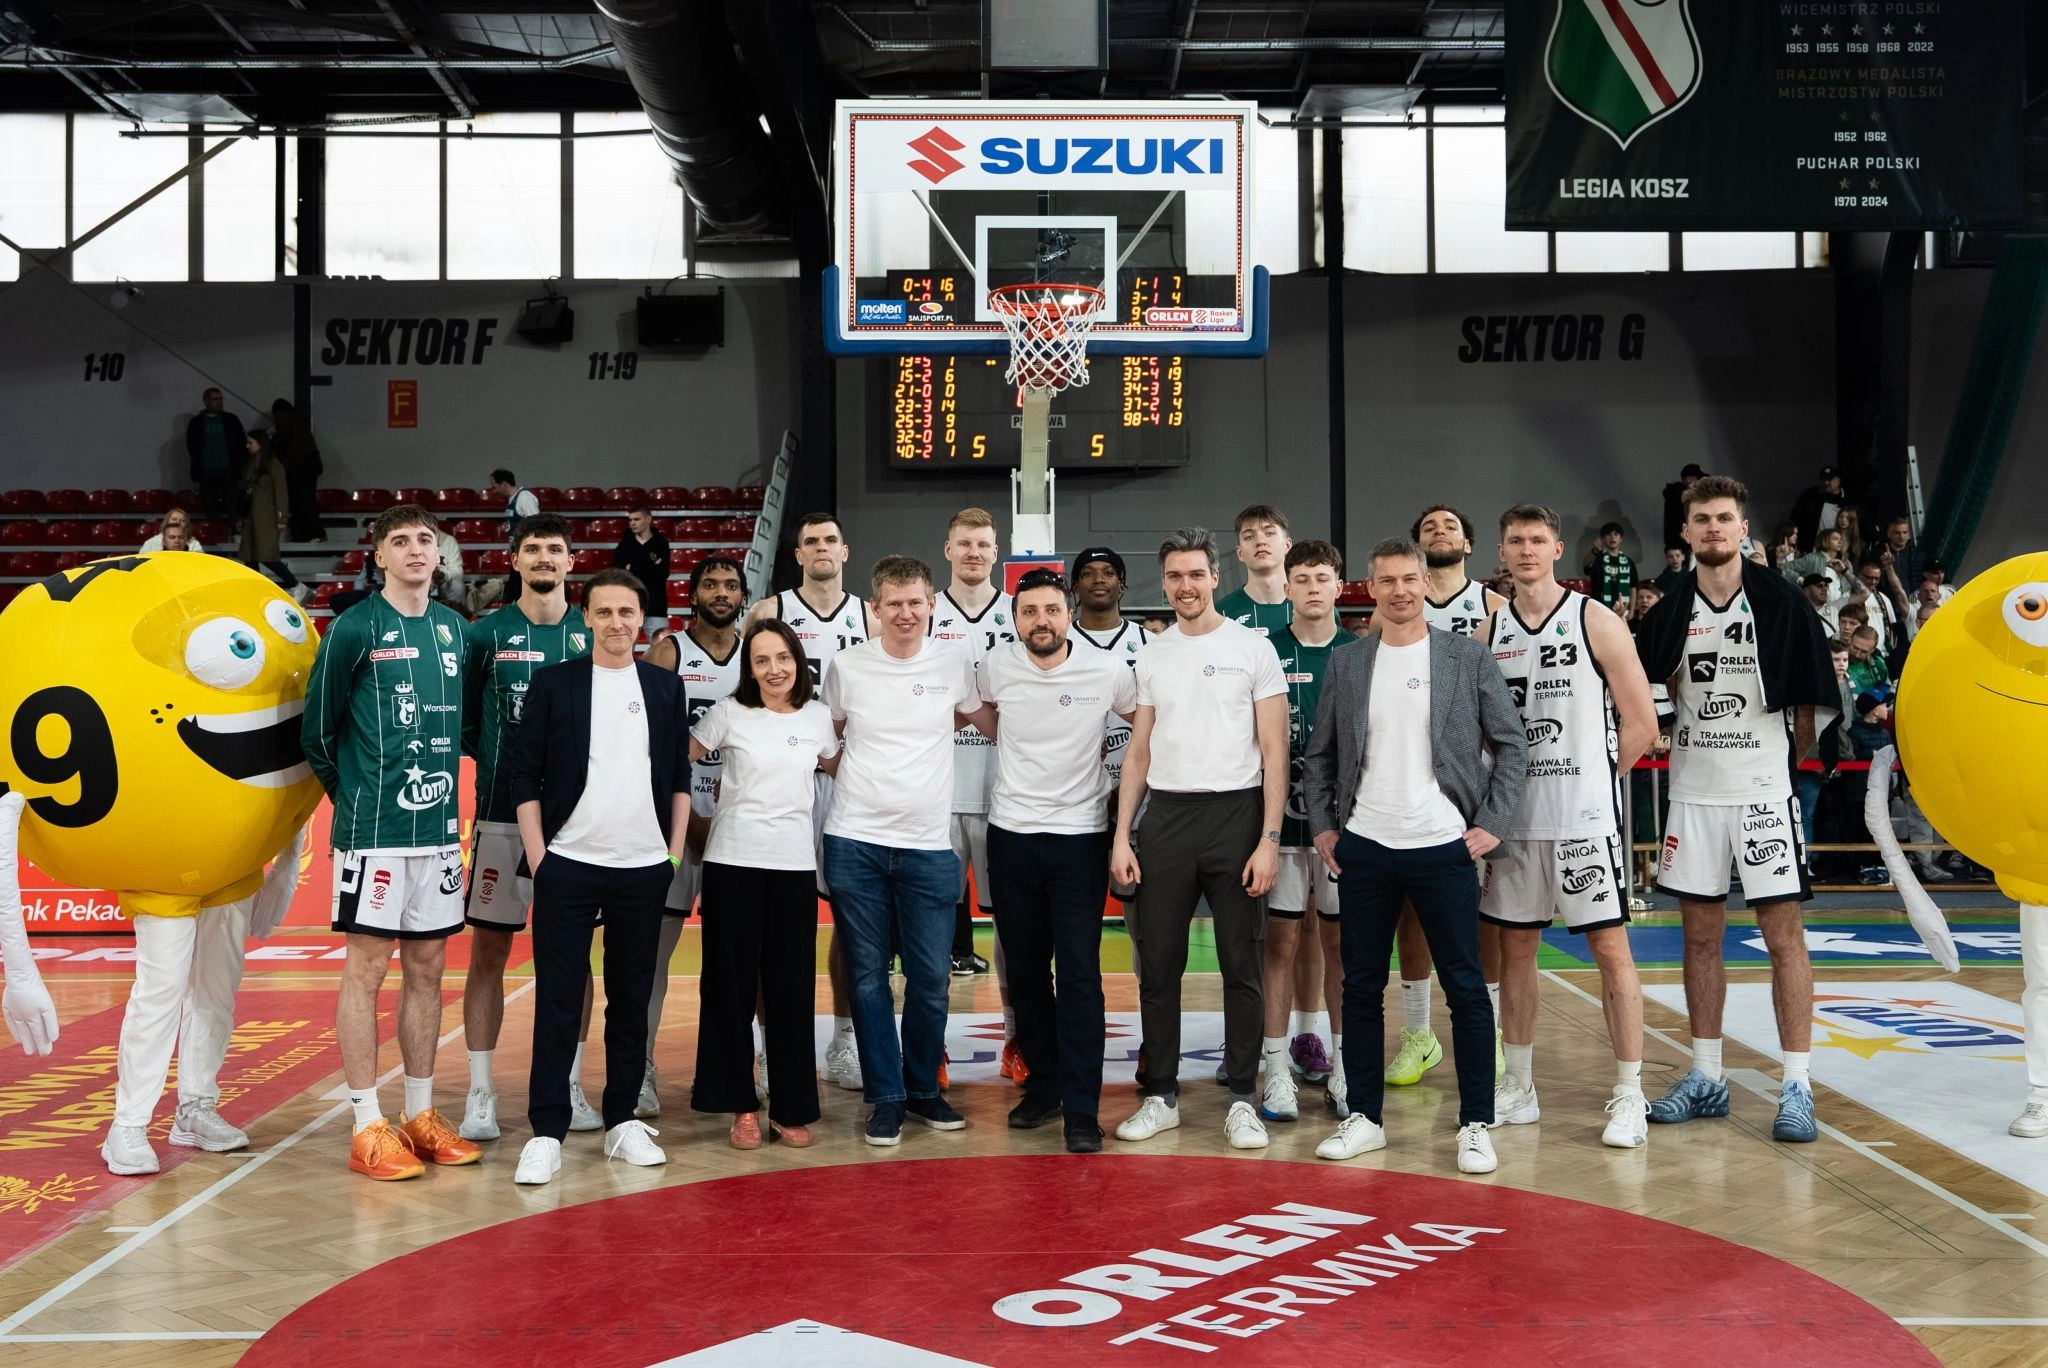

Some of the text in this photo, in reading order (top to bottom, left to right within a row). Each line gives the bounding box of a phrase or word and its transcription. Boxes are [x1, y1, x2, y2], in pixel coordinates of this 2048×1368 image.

[1780, 3, 1941, 15] WICEMISTRZ POLSKI
[1786, 43, 1809, 53] 1953
[1816, 43, 1839, 53] 1955
[1907, 42, 1934, 52] 2022
[1776, 67, 1945, 82] BRĄZOWY MEDALISTA
[1778, 86, 1943, 98] MISTRZOSTW POLSKI
[1834, 131, 1887, 142] 1952 1962
[980, 137, 1224, 175] SUZUKI
[1797, 157, 1920, 169] PUCHAR POLSKI
[1560, 178, 1689, 198] LEGIA KOSZ
[1834, 196, 1888, 207] 1970 2024
[940, 277, 954, 292] 16
[1173, 276, 1181, 290] 7
[1171, 292, 1181, 304] 4
[861, 304, 901, 314] molten
[1150, 312, 1189, 322] ORLEN
[321, 318, 498, 366] SEKTOR F
[1458, 313, 1646, 363] SEKTOR G
[84, 353, 125, 382] 1-10
[588, 351, 639, 381] 11-19
[945, 368, 955, 383] 6
[1168, 367, 1182, 381] 19
[945, 383, 955, 398] 0
[1172, 381, 1182, 396] 3
[395, 392, 411, 416] F
[941, 399, 955, 412] 14
[1173, 397, 1183, 410] 4
[946, 413, 955, 428] 9
[1168, 411, 1183, 426] 13
[945, 429, 955, 444] 0
[950, 444, 956, 458] 1
[972, 435, 986, 458] 5
[1091, 434, 1105, 457] 5
[790, 618, 806, 627] 4F
[382, 631, 400, 643] 4F
[507, 635, 526, 645] 4F
[1500, 634, 1516, 645] 4F
[494, 652, 517, 660] ORLEN
[1540, 643, 1578, 669] 23
[441, 652, 458, 677] 5
[687, 660, 703, 668] 4F
[1534, 679, 1571, 691] ORLEN
[1534, 690, 1574, 700] TERMIKA
[422, 703, 457, 713] Warszawa
[1703, 698, 1737, 716] LOTTO
[430, 737, 451, 746] ORLEN
[1106, 731, 1130, 748] OTTO
[1700, 731, 1753, 740] TRAMWAJE
[1692, 739, 1761, 749] WARSZAWSKIE
[1527, 757, 1572, 768] AMWAJE
[1526, 767, 1581, 778] RSZAWSKIE
[411, 778, 447, 803] LOTTO
[1743, 817, 1785, 832] UNIQA
[1556, 844, 1600, 861] UNIQA
[1750, 842, 1780, 862] LOTTO
[1772, 865, 1791, 876] 4F
[1569, 869, 1597, 890] LOTTO
[1592, 890, 1610, 903] 4F
[1818, 1006, 2025, 1048] LOTTO
[991, 1202, 1377, 1327] ORLEN
[1107, 1222, 1507, 1353] TERMIKA
